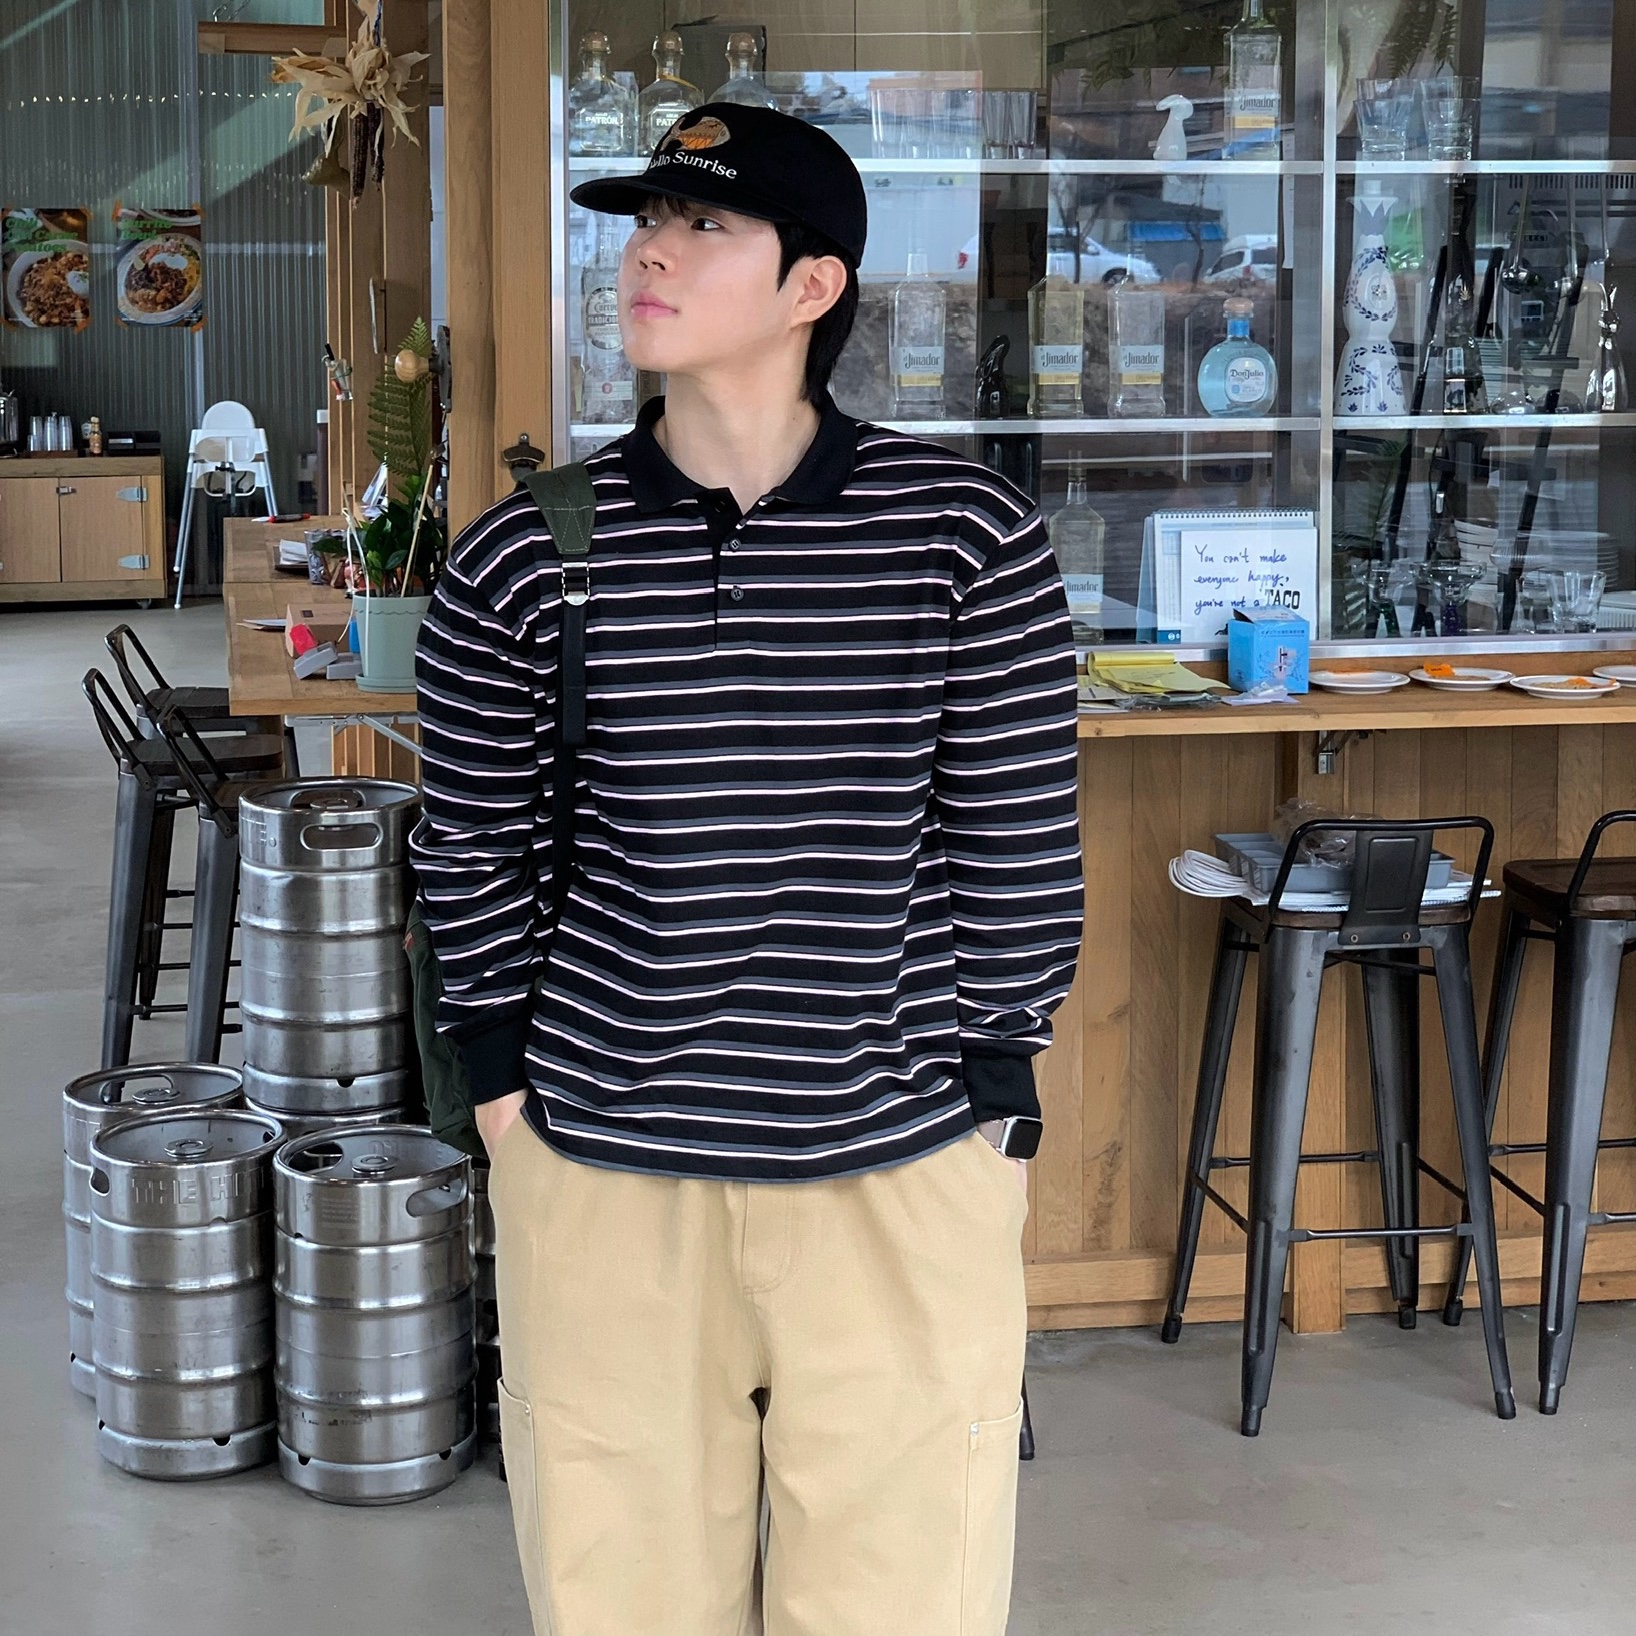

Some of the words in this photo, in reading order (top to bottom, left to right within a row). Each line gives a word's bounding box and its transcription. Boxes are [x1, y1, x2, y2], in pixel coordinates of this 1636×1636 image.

[672, 151, 737, 179] Sunrise
[904, 352, 940, 369] Jimador
[1042, 352, 1078, 368] Jimador
[1125, 352, 1160, 368] Jimador
[1195, 544, 1214, 562] You
[1223, 547, 1249, 563] can't
[1260, 549, 1287, 563] make
[1194, 575, 1239, 589] everyone
[1194, 599, 1224, 615] you're
[1231, 596, 1246, 607] not
[1264, 589, 1301, 610] TACO
